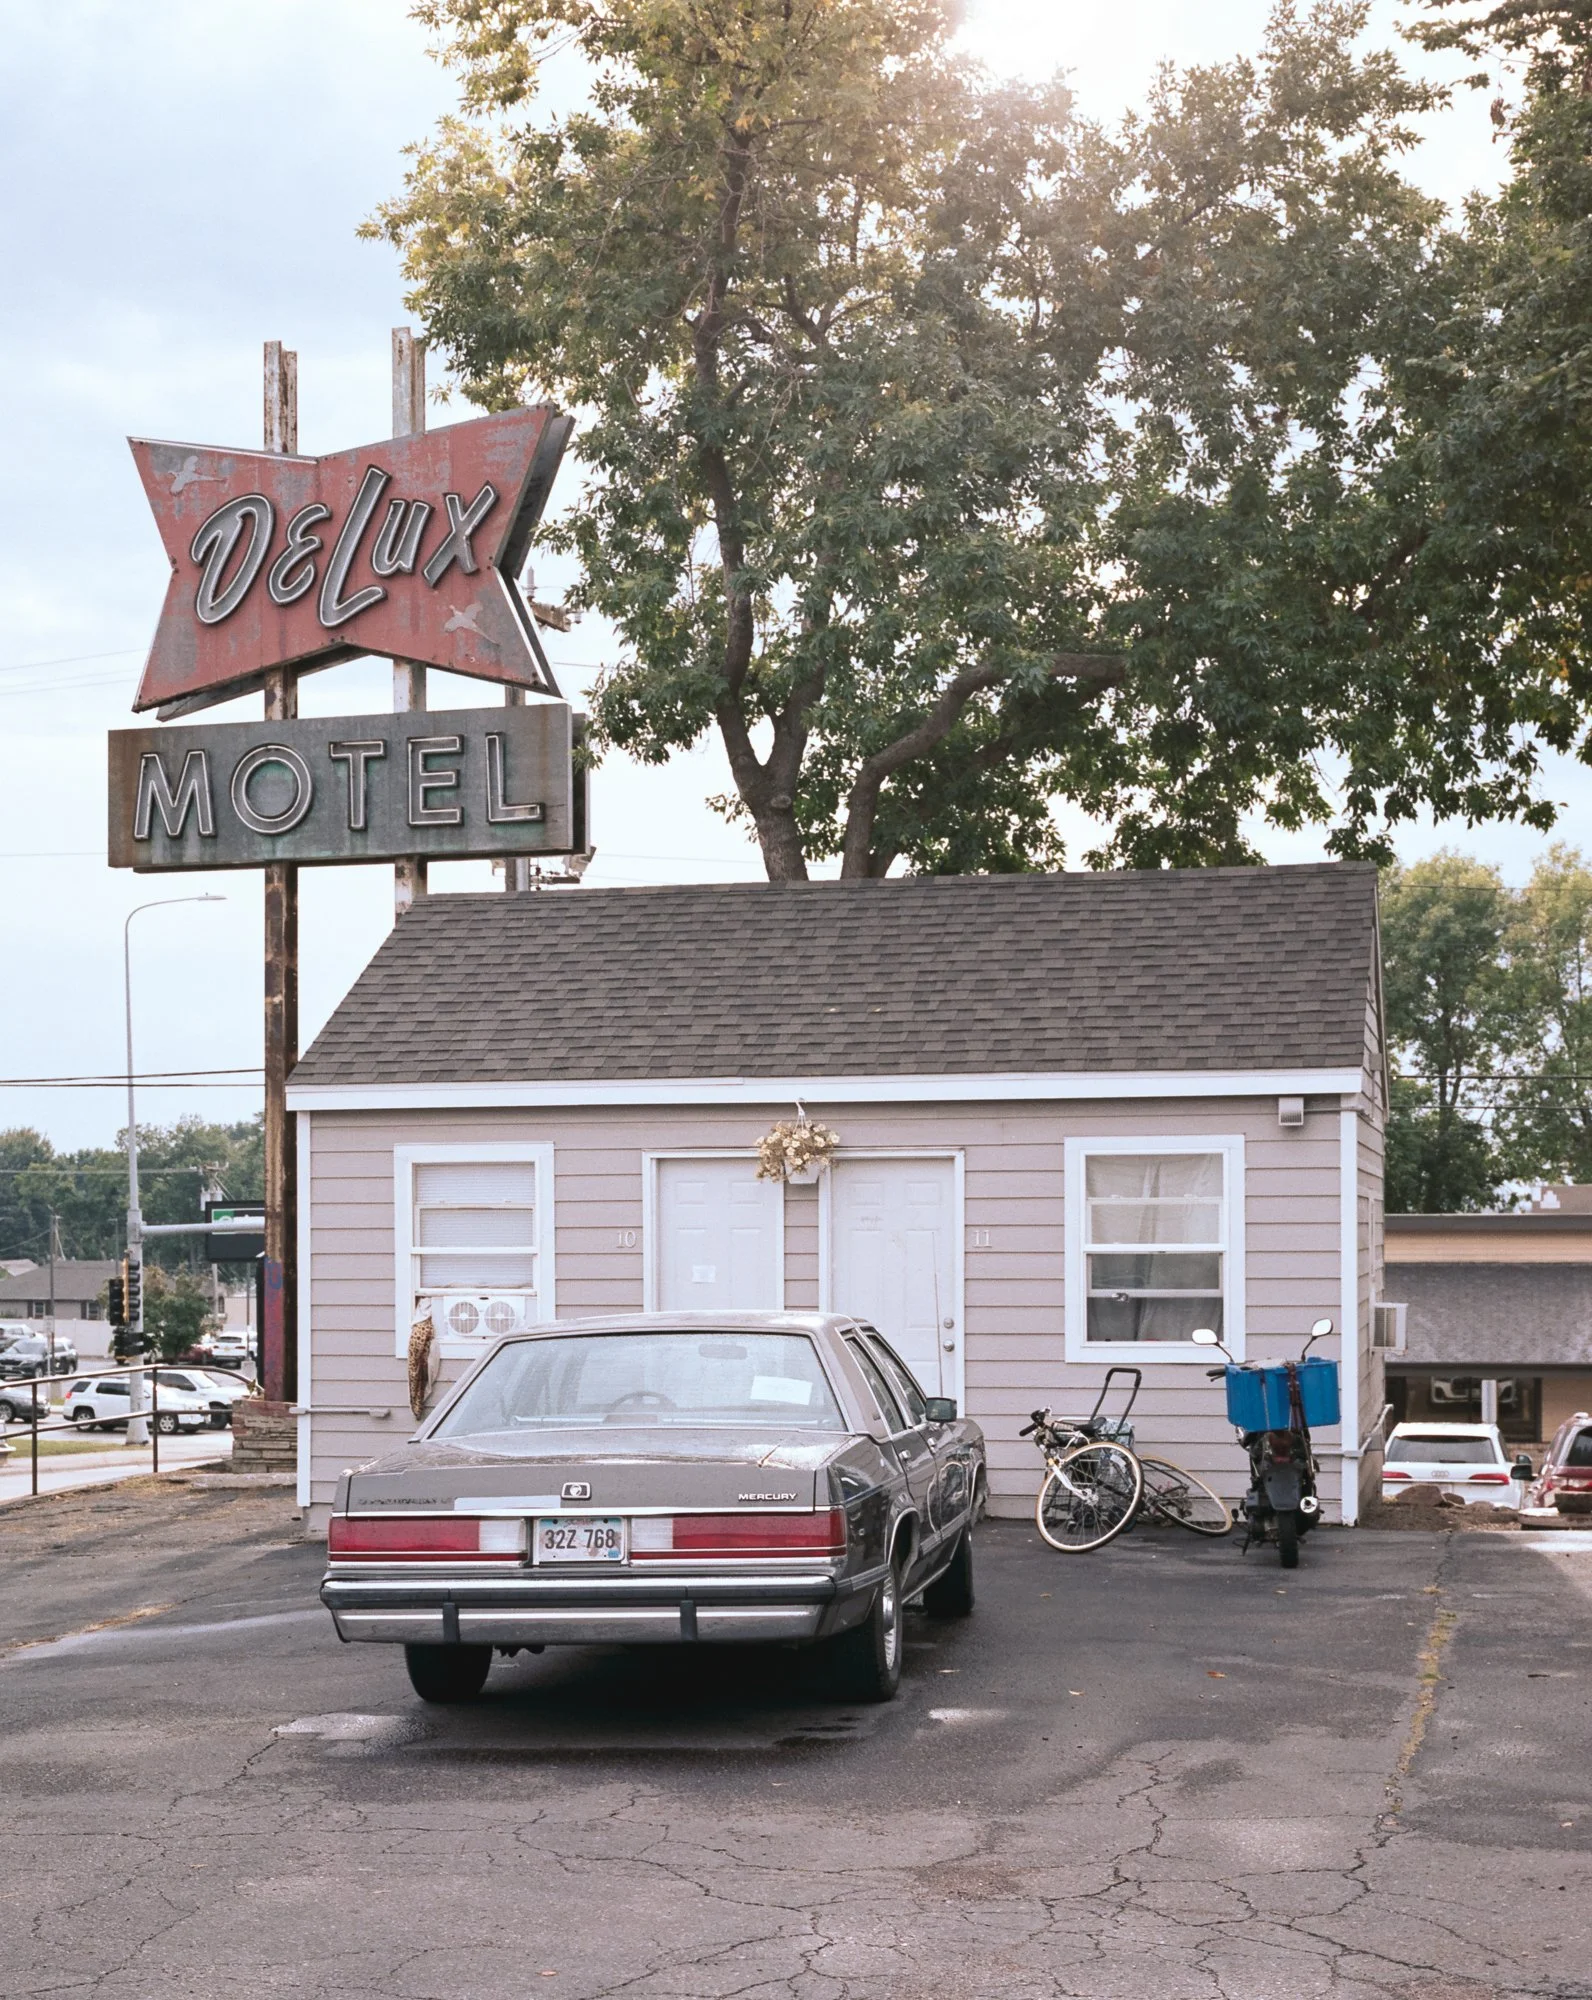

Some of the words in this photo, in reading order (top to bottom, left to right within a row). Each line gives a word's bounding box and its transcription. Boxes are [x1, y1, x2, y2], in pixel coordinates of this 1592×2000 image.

[132, 731, 545, 840] MOTEL
[616, 1230, 637, 1249] 10
[973, 1230, 993, 1249] 11
[738, 1493, 798, 1501] MERCURY
[545, 1529, 578, 1549] 32Z
[584, 1528, 616, 1549] 768
